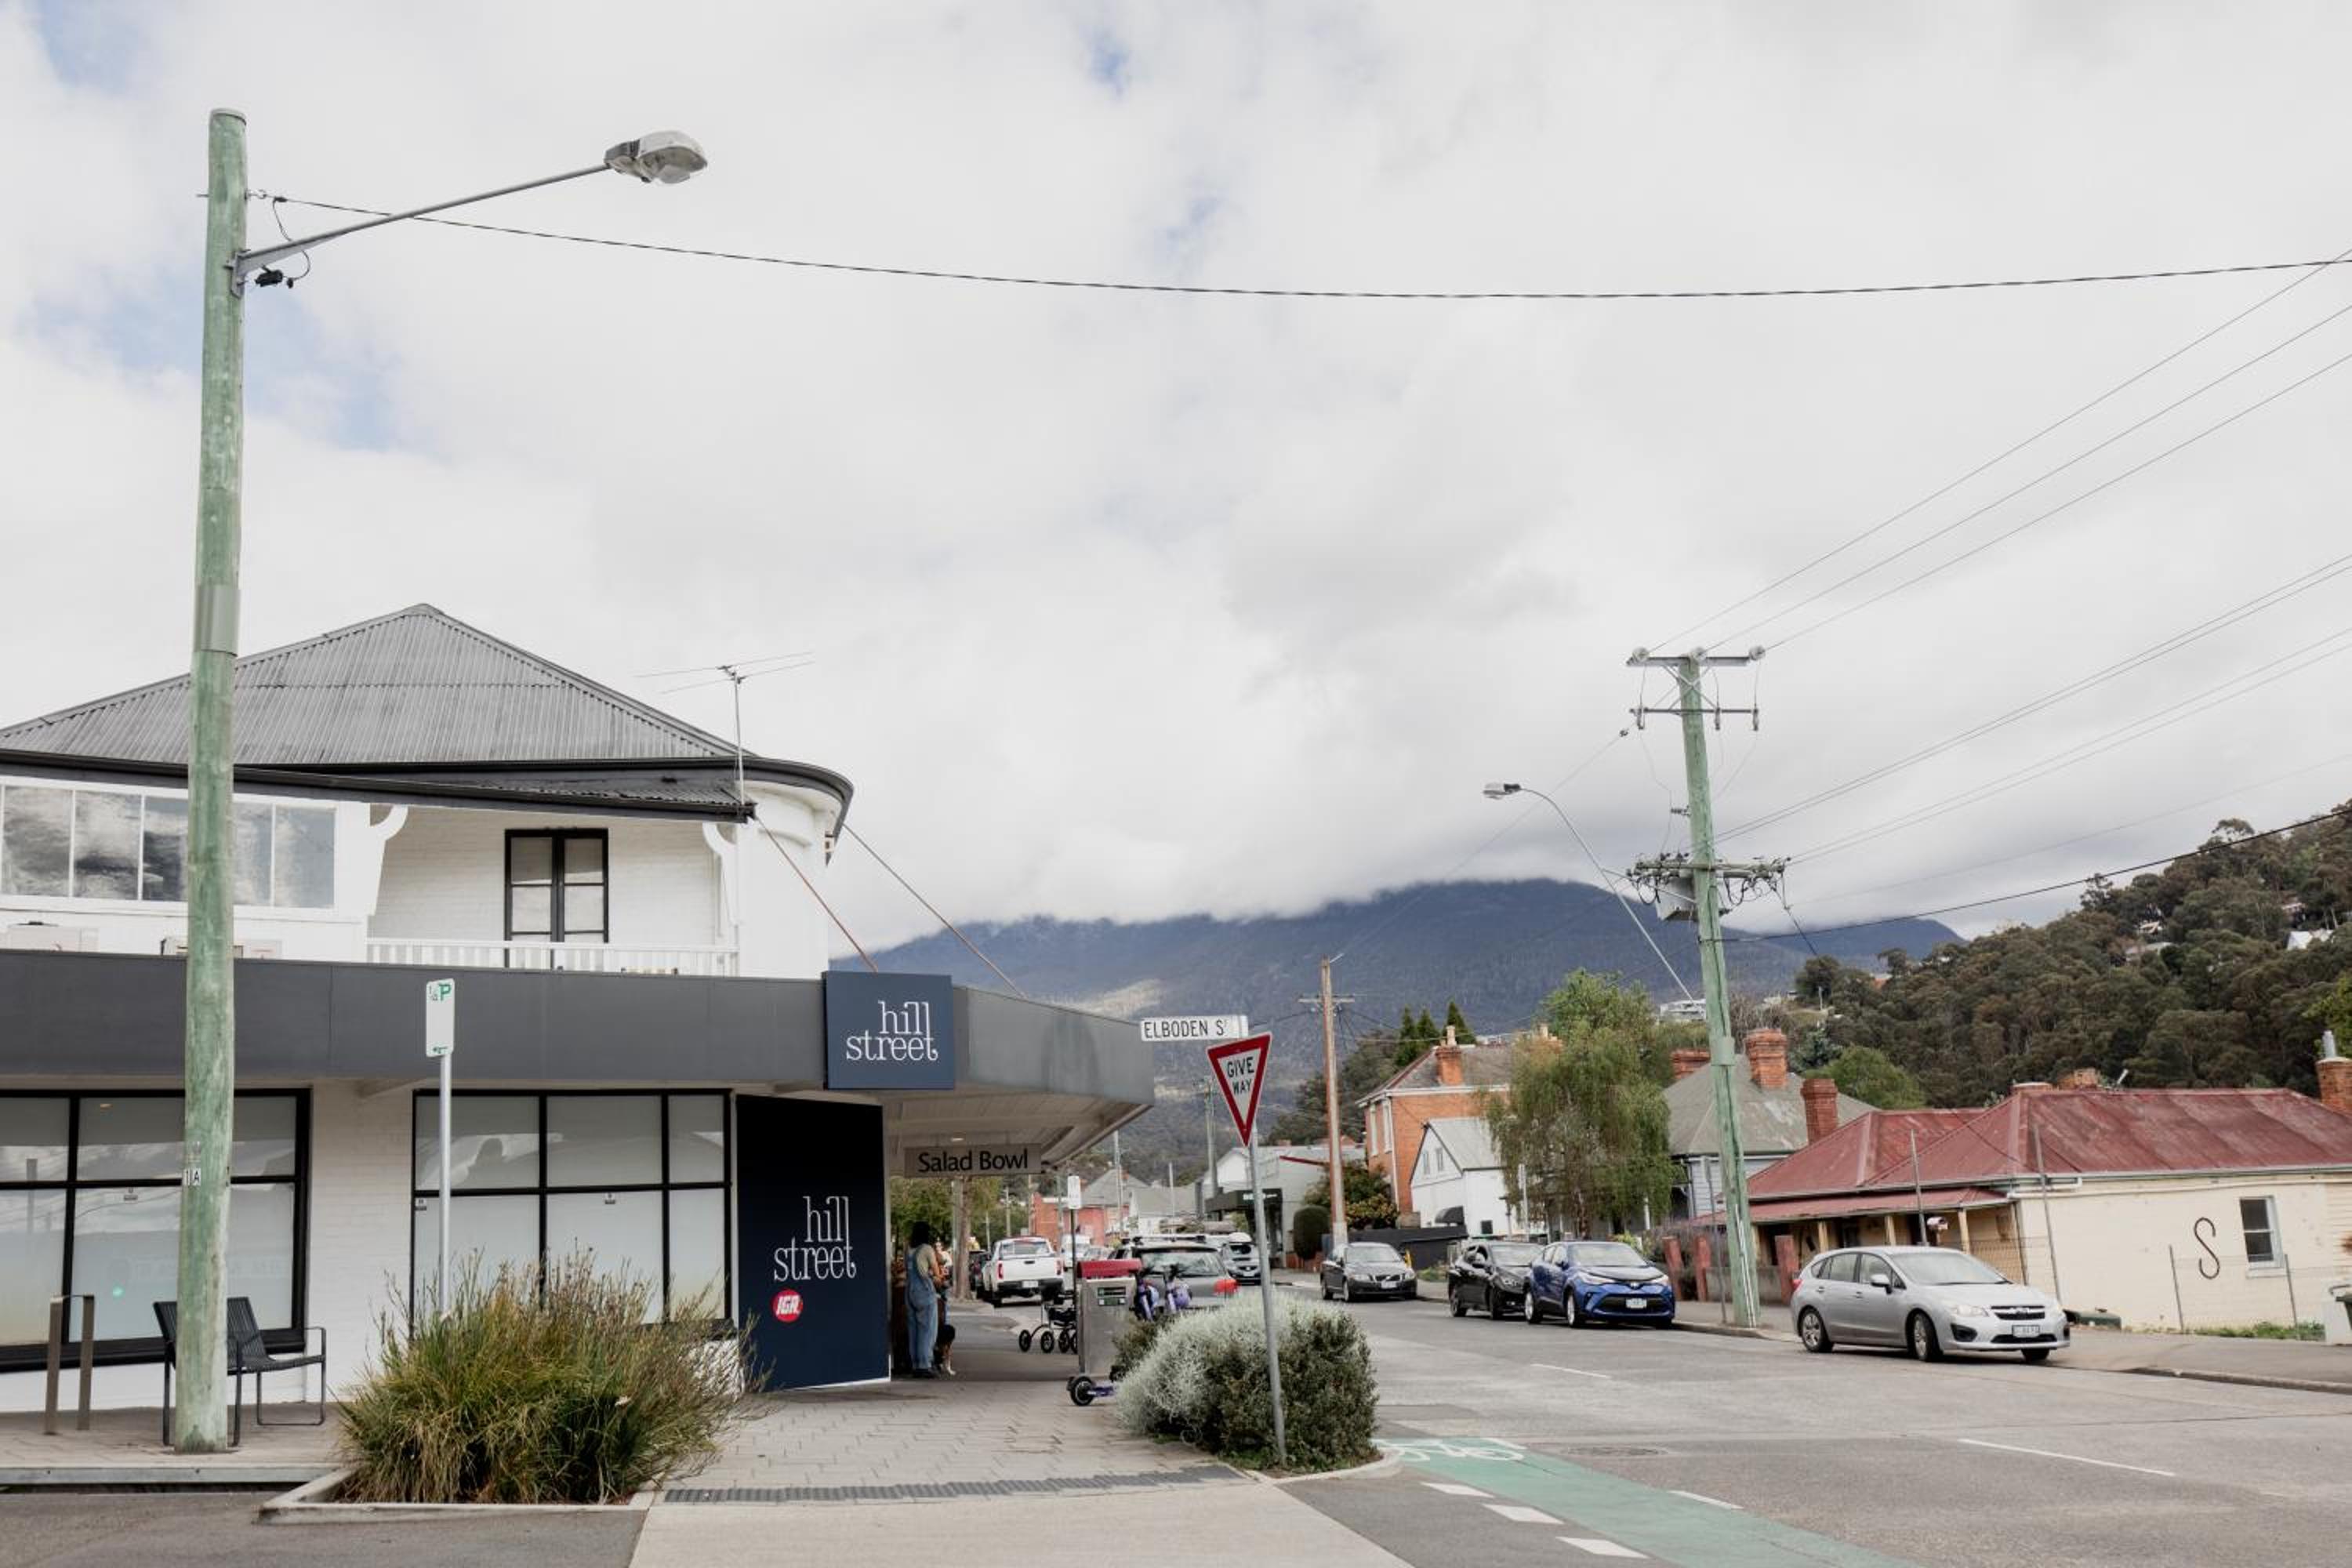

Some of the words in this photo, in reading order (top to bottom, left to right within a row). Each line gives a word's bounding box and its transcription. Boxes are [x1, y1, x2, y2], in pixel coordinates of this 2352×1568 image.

[877, 1000, 930, 1035] hill
[1144, 1020, 1208, 1039] ELBODEN
[846, 1029, 938, 1062] street
[1226, 1056, 1254, 1078] GIVE
[1232, 1079, 1252, 1095] WAY
[917, 1150, 972, 1173] Salad
[979, 1148, 1028, 1171] Bowl
[803, 1196, 849, 1243] hill
[774, 1236, 857, 1282] street
[775, 1294, 801, 1316] IGA
